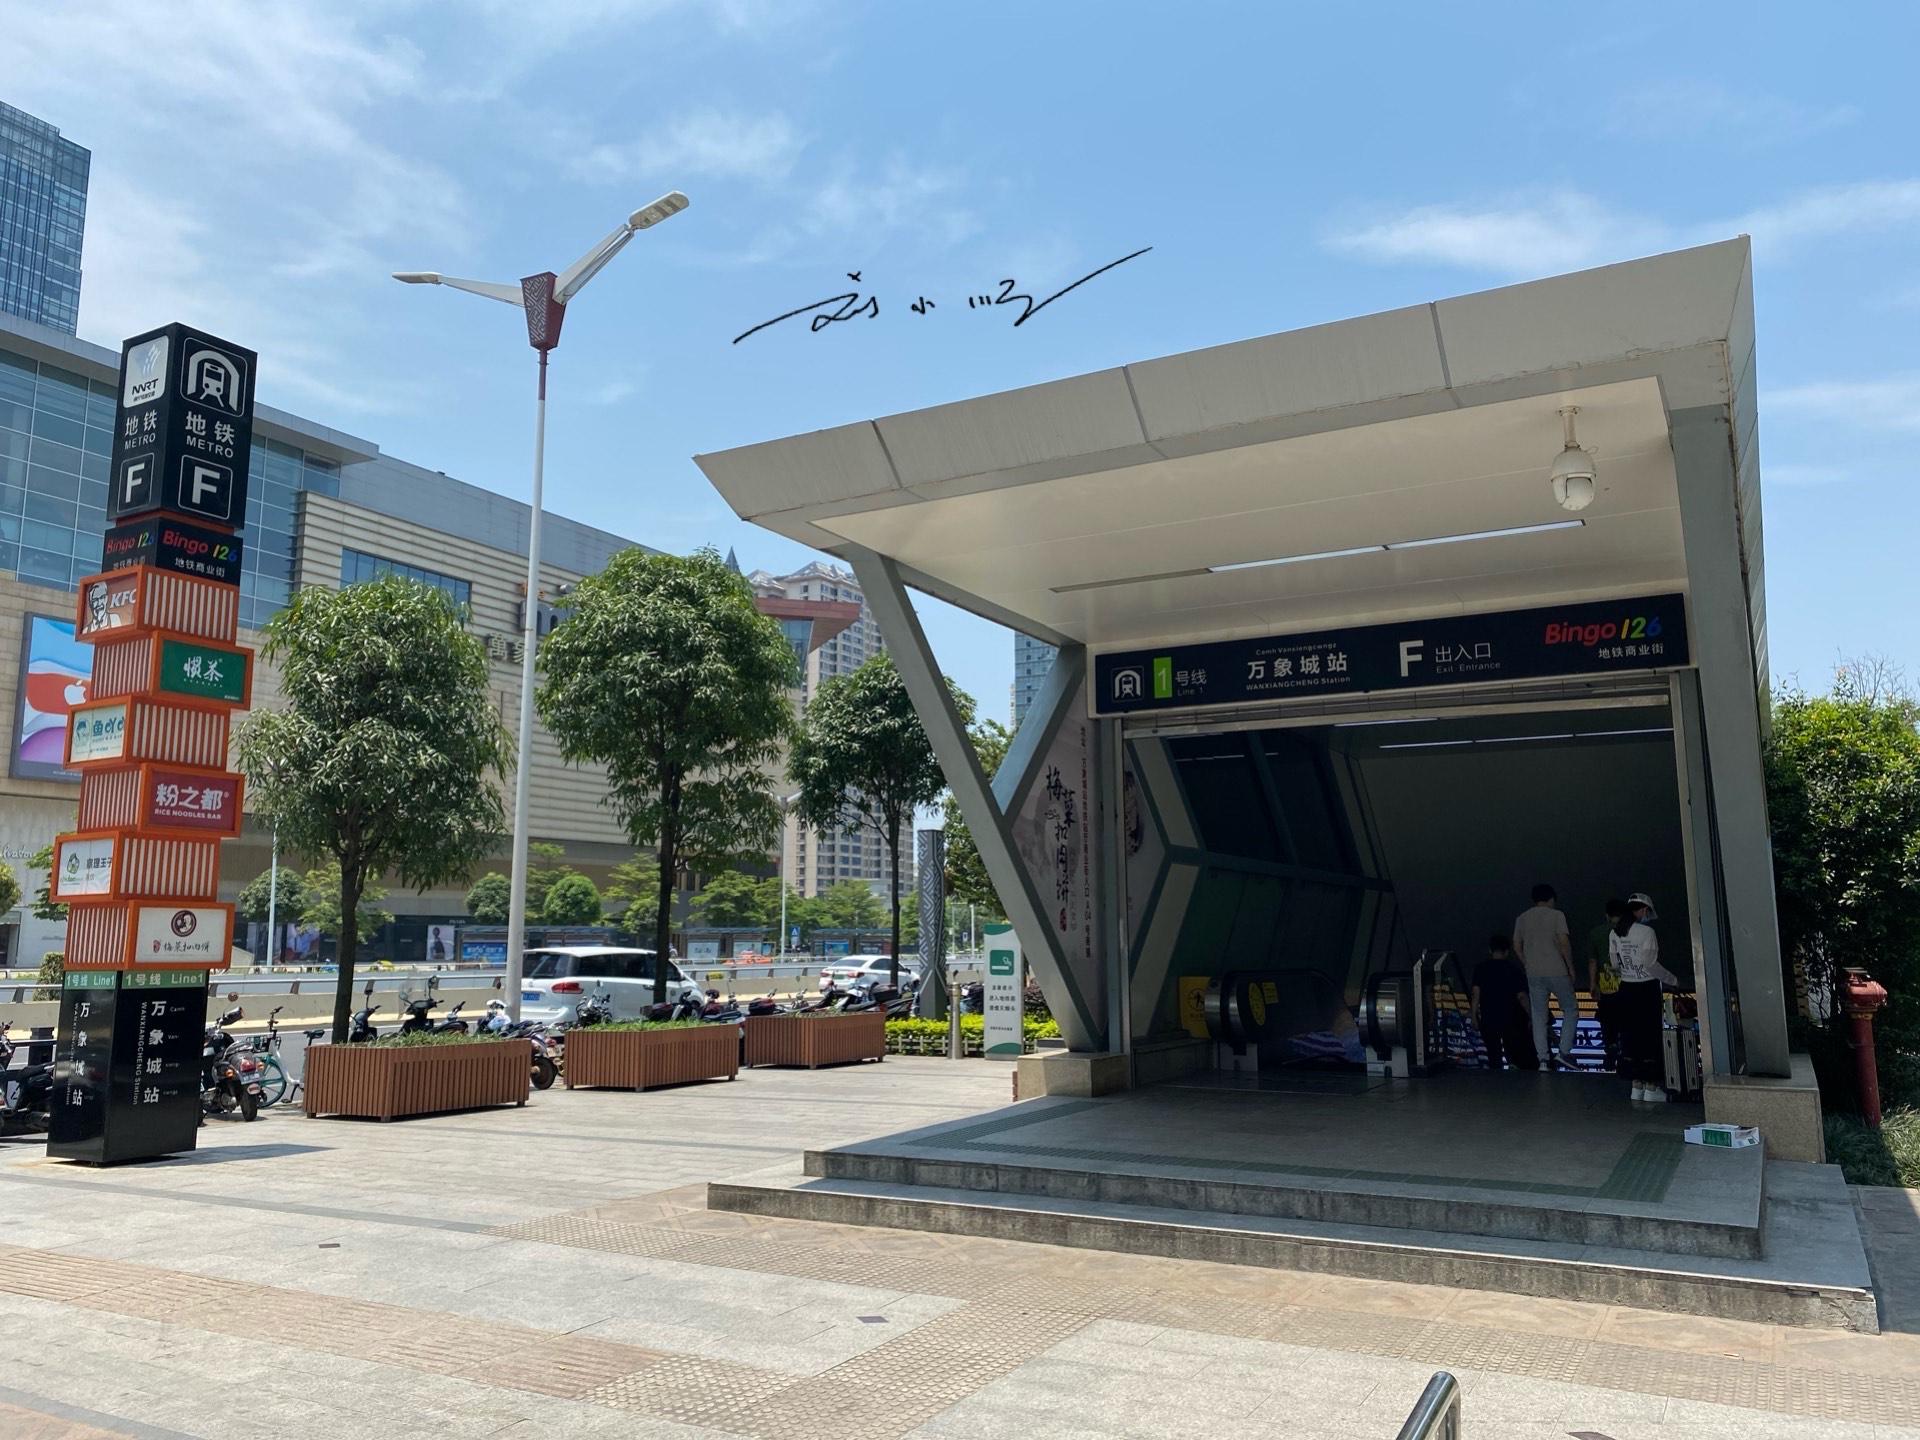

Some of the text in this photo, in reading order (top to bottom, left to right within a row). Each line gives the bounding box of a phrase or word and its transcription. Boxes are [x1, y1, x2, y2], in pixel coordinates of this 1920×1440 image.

[125, 409, 157, 436] 地铁
[185, 411, 235, 445] 地铁
[124, 433, 156, 450] METRO
[186, 435, 234, 458] METRO
[125, 462, 145, 503] F
[192, 465, 220, 504] F
[106, 530, 155, 555] Bingo 126
[163, 529, 238, 562] Bingo 126
[175, 557, 225, 578] 地铁商业街
[110, 588, 137, 609] KFC
[1545, 616, 1663, 647] Bingo 126
[1400, 639, 1424, 677] F
[1435, 642, 1491, 663] 出入口
[1598, 642, 1664, 659] 地铁商业街
[1247, 651, 1348, 680] 万象城站
[1436, 662, 1501, 673] Exit Entrance
[1177, 687, 1196, 696] Line
[1246, 676, 1351, 691] WANXIANGCHENG Station
[155, 783, 224, 811] 粉之都
[154, 808, 222, 820] RICE NOODLES BAR
[66, 973, 88, 987] 1号线
[125, 973, 161, 987] 1号线
[71, 1002, 91, 1107] 万象城站
[132, 1001, 148, 1105] WANXIANGCHENG Station
[143, 1000, 167, 1103] 万象城站
